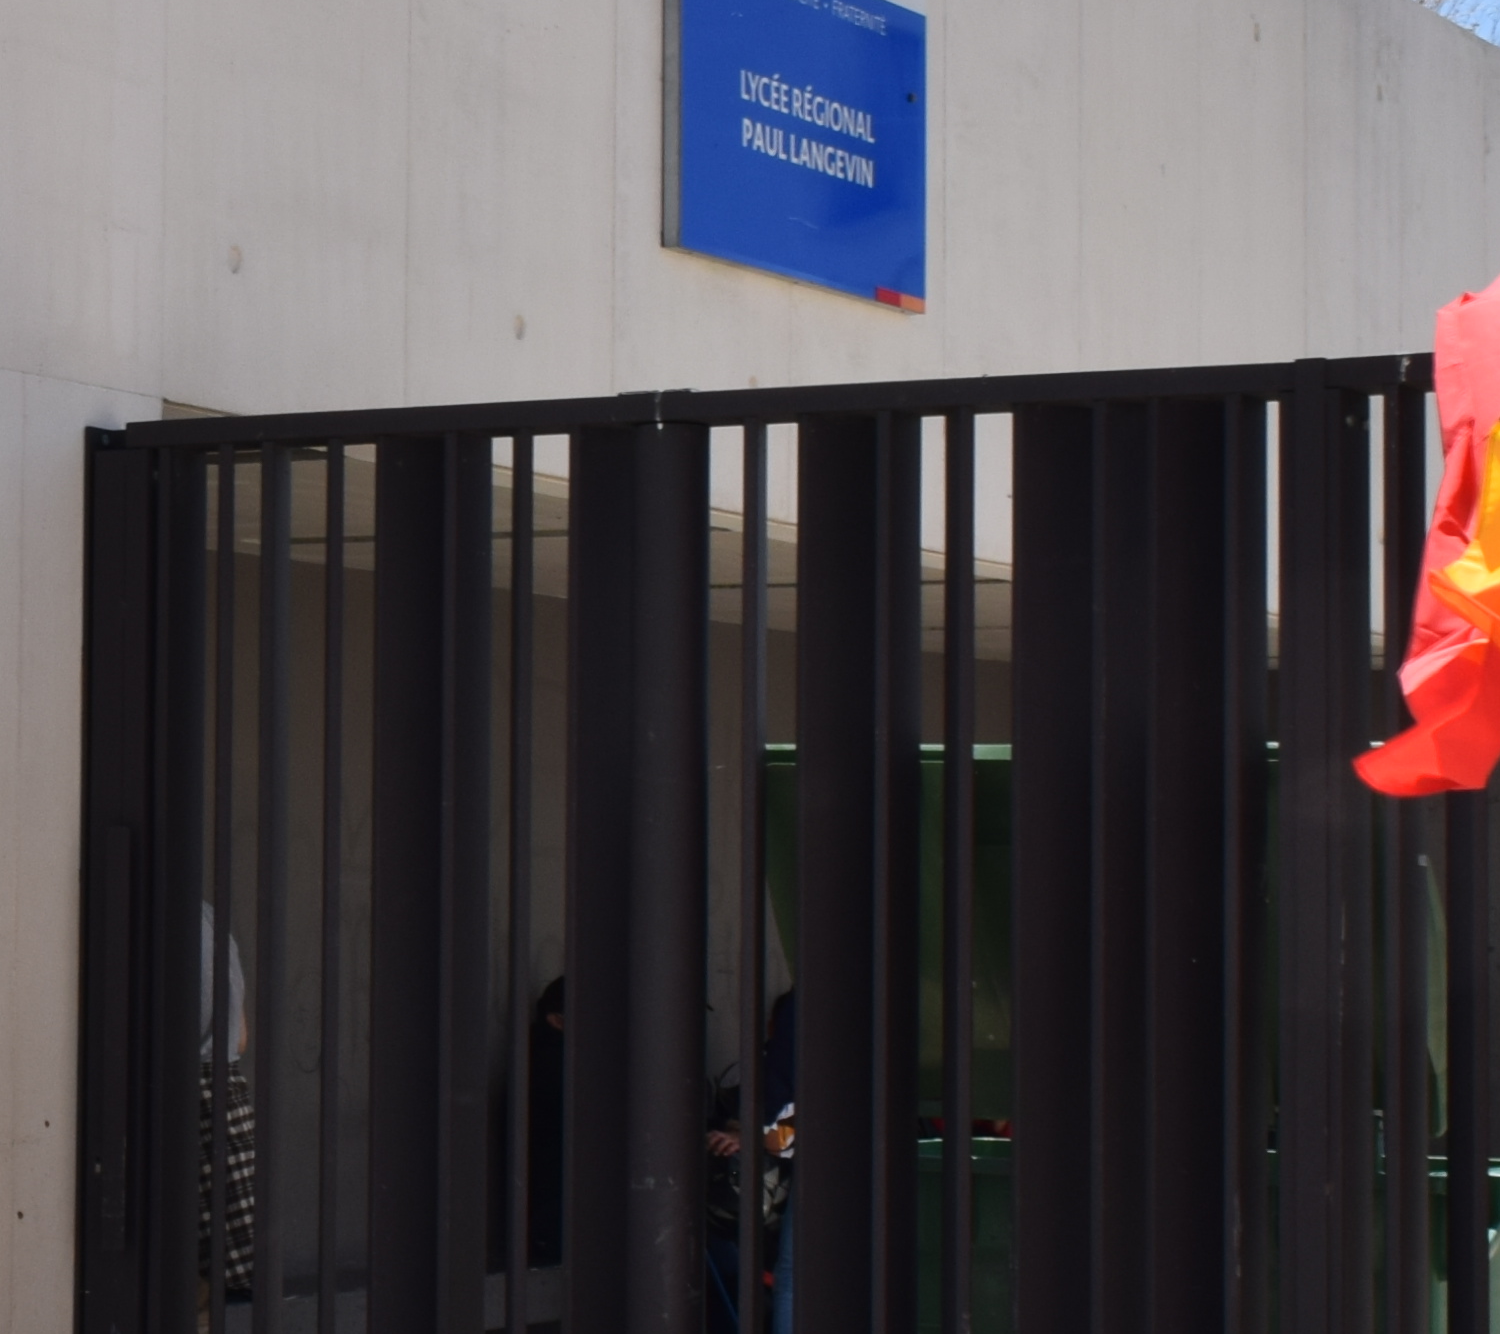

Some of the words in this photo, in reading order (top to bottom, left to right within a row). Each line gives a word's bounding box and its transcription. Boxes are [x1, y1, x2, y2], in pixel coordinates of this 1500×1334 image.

[740, 69, 789, 115] LYCÉE
[792, 85, 876, 144] RÉGIONAL
[741, 117, 788, 161] PAUL
[789, 133, 875, 189] LANGEVIN
